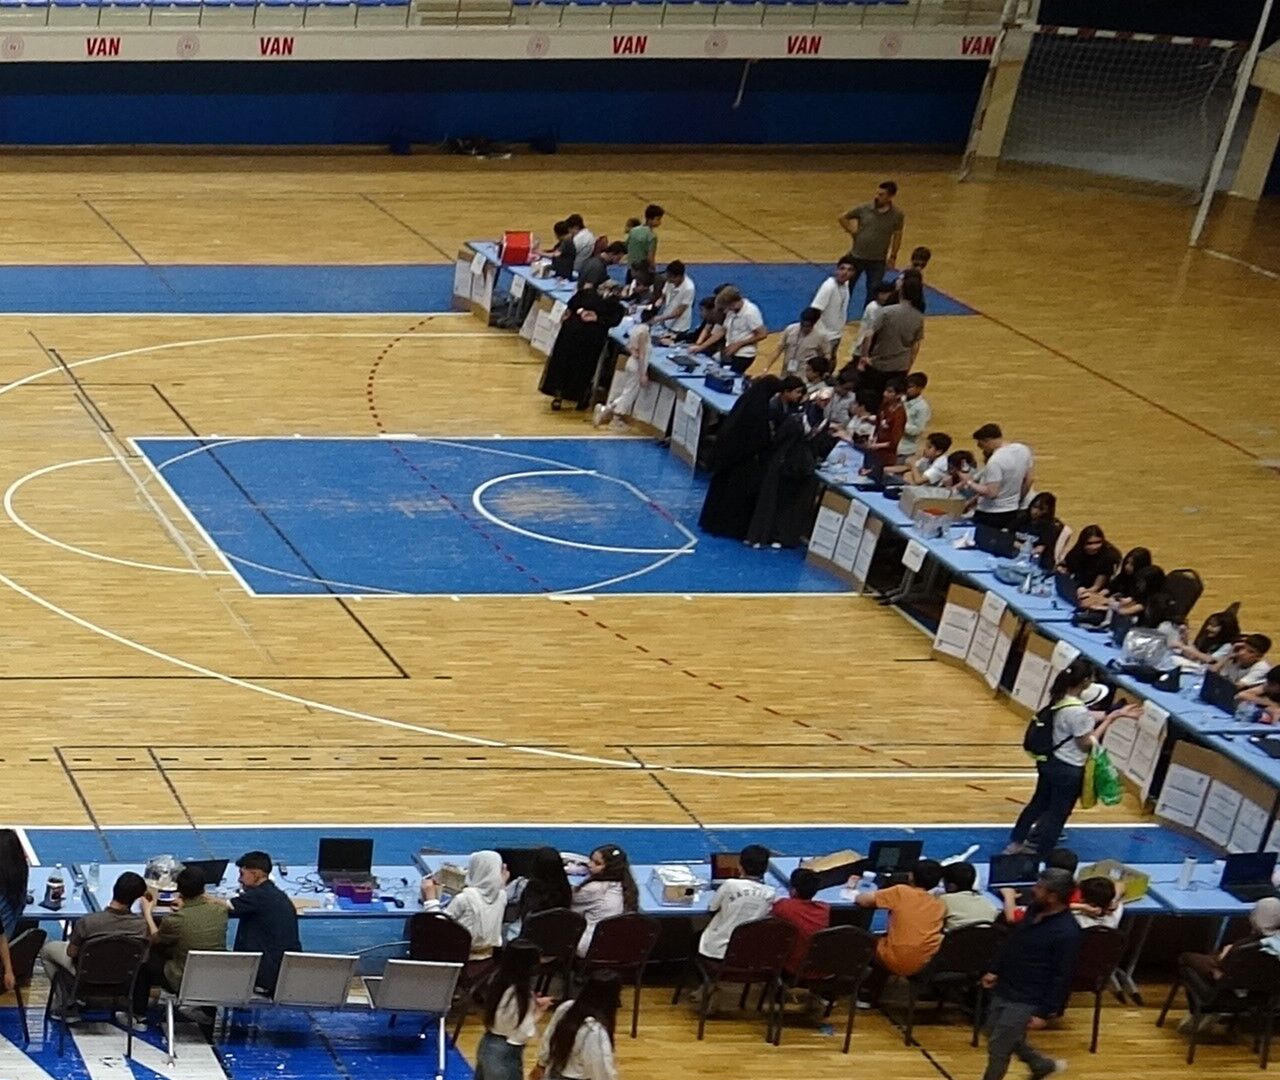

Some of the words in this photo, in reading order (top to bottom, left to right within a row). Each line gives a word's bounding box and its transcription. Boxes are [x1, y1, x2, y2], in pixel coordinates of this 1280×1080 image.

[86, 38, 121, 55] VAN
[260, 37, 295, 55] VAN
[612, 37, 648, 54] VAN
[787, 37, 823, 53] VAN
[961, 36, 996, 55] VAN
